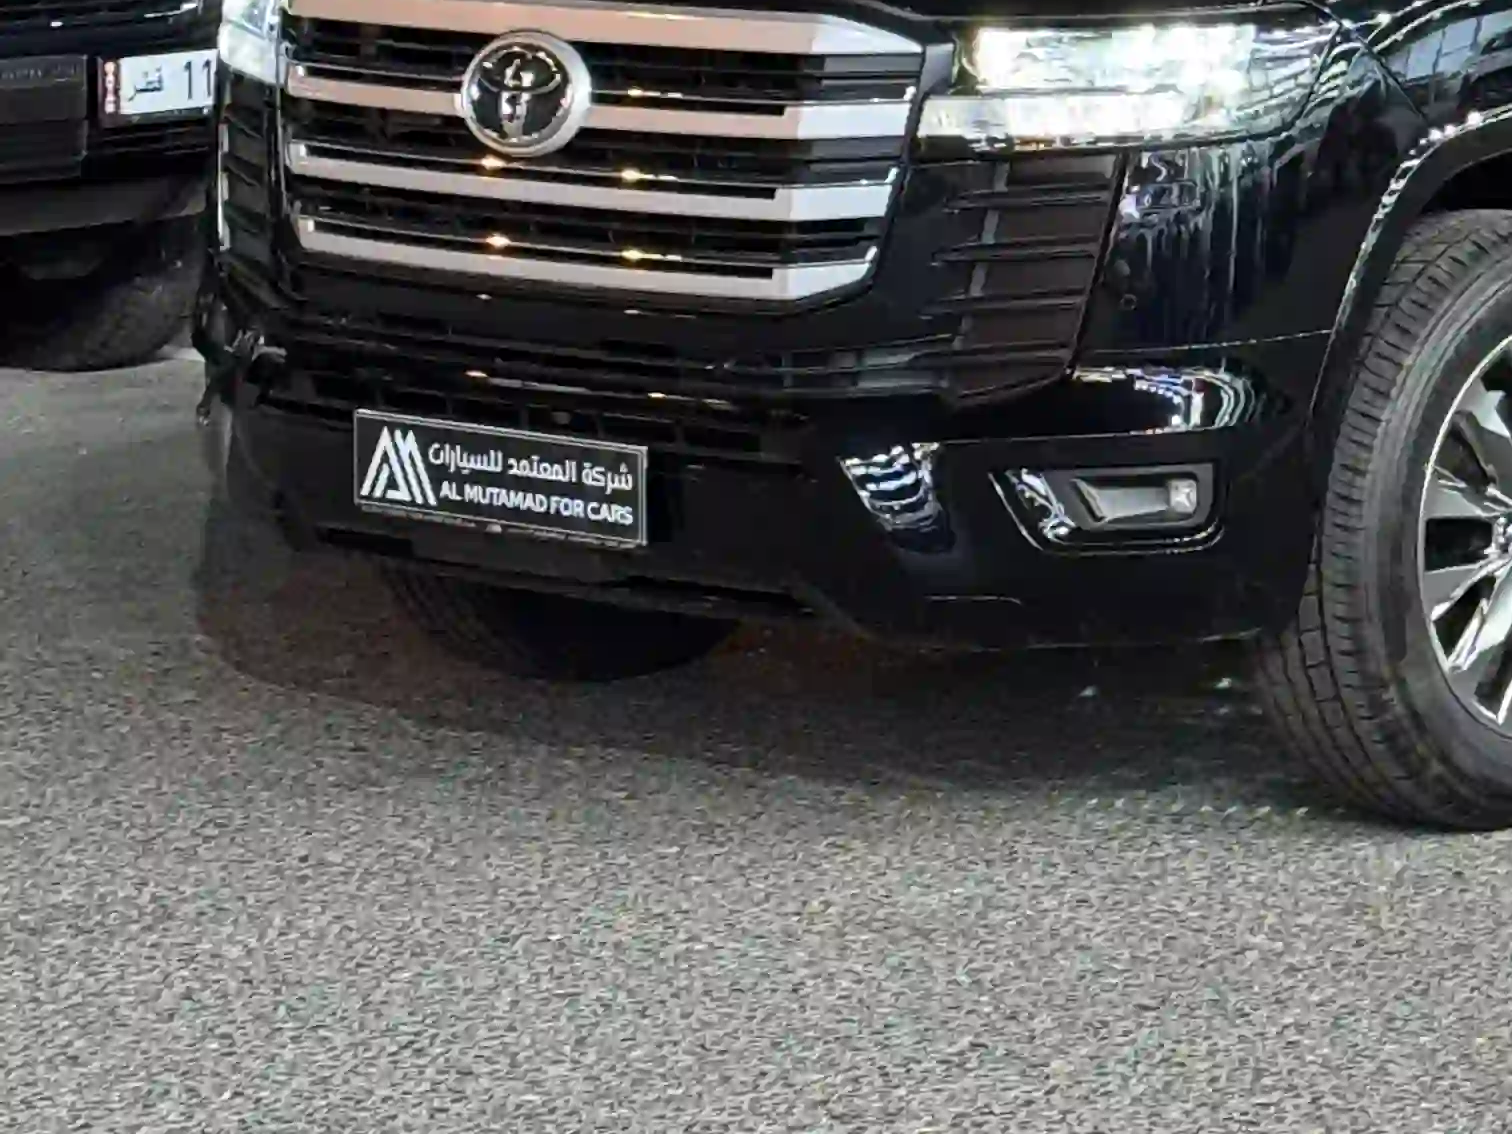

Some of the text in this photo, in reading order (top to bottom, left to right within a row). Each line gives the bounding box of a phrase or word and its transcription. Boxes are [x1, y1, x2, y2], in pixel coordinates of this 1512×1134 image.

[428, 443, 633, 494] شركة المعتمد للسيارات
[439, 480, 634, 526] AL MUTAMAD FOR CARS
